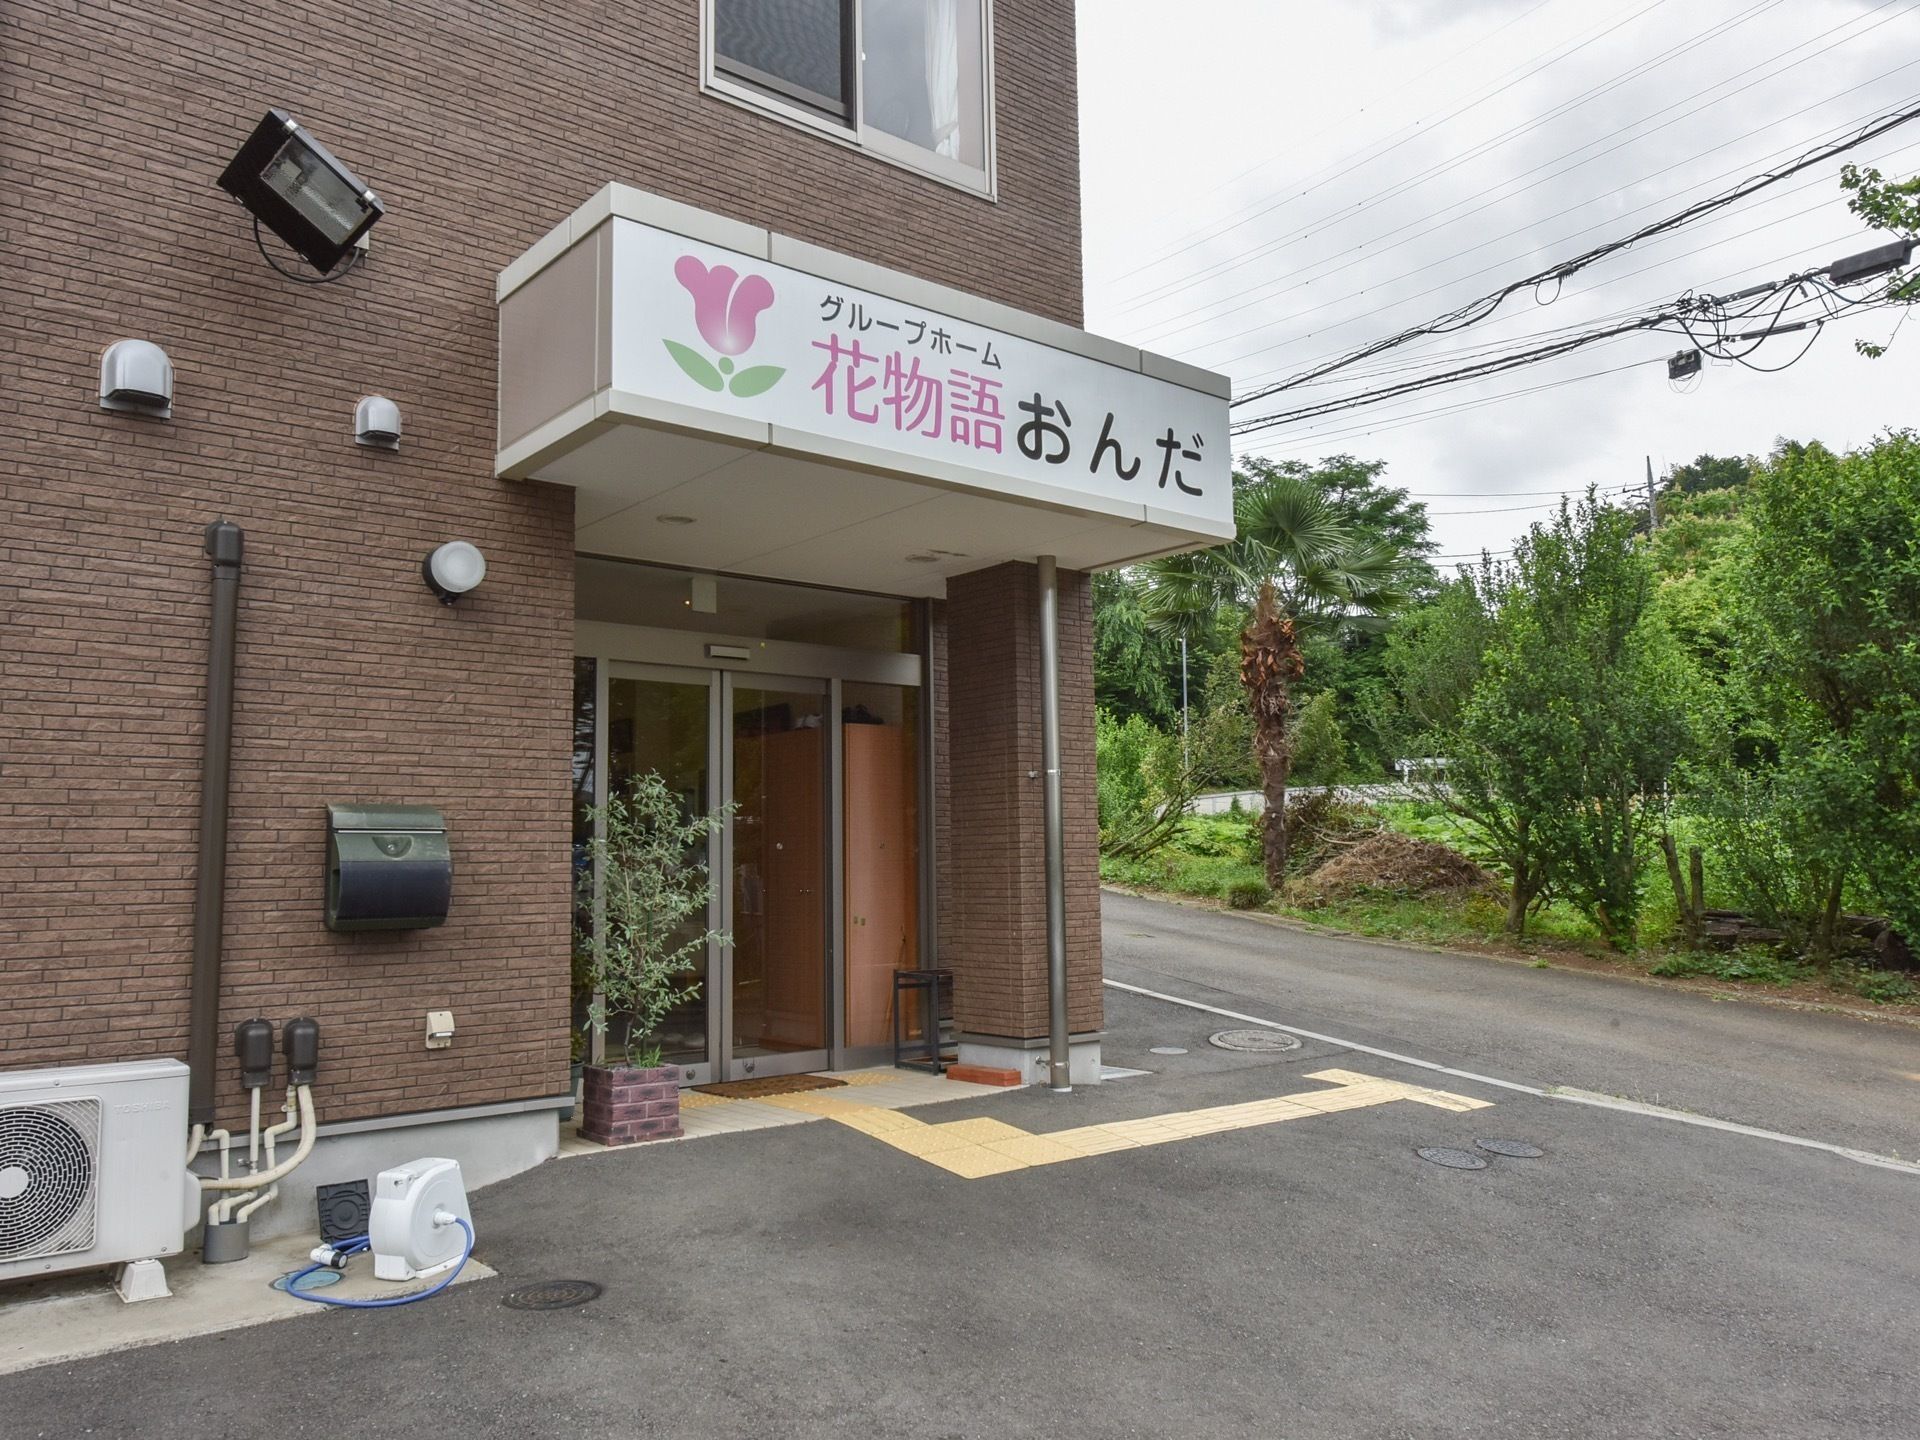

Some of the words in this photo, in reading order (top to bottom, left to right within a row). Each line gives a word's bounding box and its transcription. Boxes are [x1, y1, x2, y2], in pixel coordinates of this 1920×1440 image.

[820, 295, 1002, 370] グループホーム
[811, 333, 1005, 455] 花物語
[1017, 391, 1205, 497] おんだ
[113, 1100, 173, 1115] TOSHIBA
